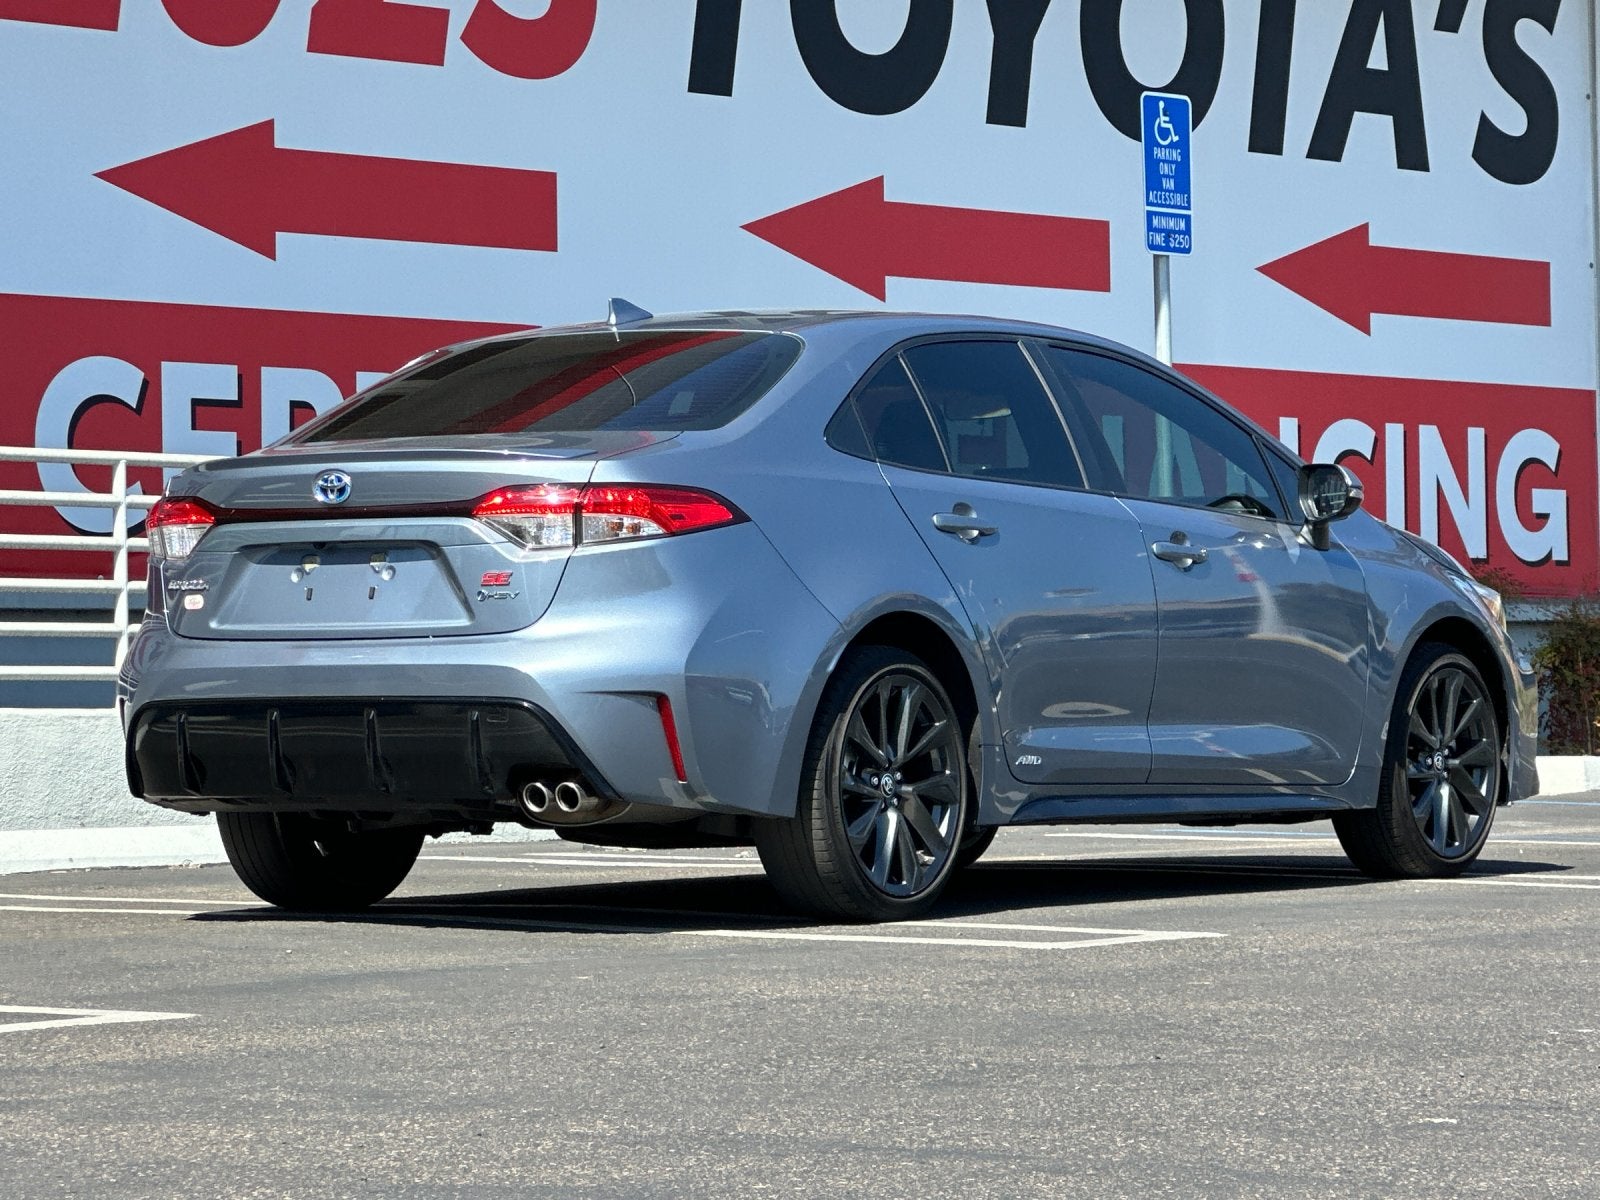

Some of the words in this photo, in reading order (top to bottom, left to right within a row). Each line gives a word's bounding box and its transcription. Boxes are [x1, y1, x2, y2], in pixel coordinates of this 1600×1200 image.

[1153, 147, 1182, 162] PARKING
[1159, 162, 1176, 176] ONLY
[1162, 177, 1175, 191] VAN
[1149, 191, 1189, 207] ACCESSIBLE
[1152, 215, 1186, 231] MINIMUM
[1149, 231, 1166, 247] FINE
[1169, 233, 1190, 249] $250
[481, 570, 513, 586] SE
[1015, 755, 1042, 766] AWD
